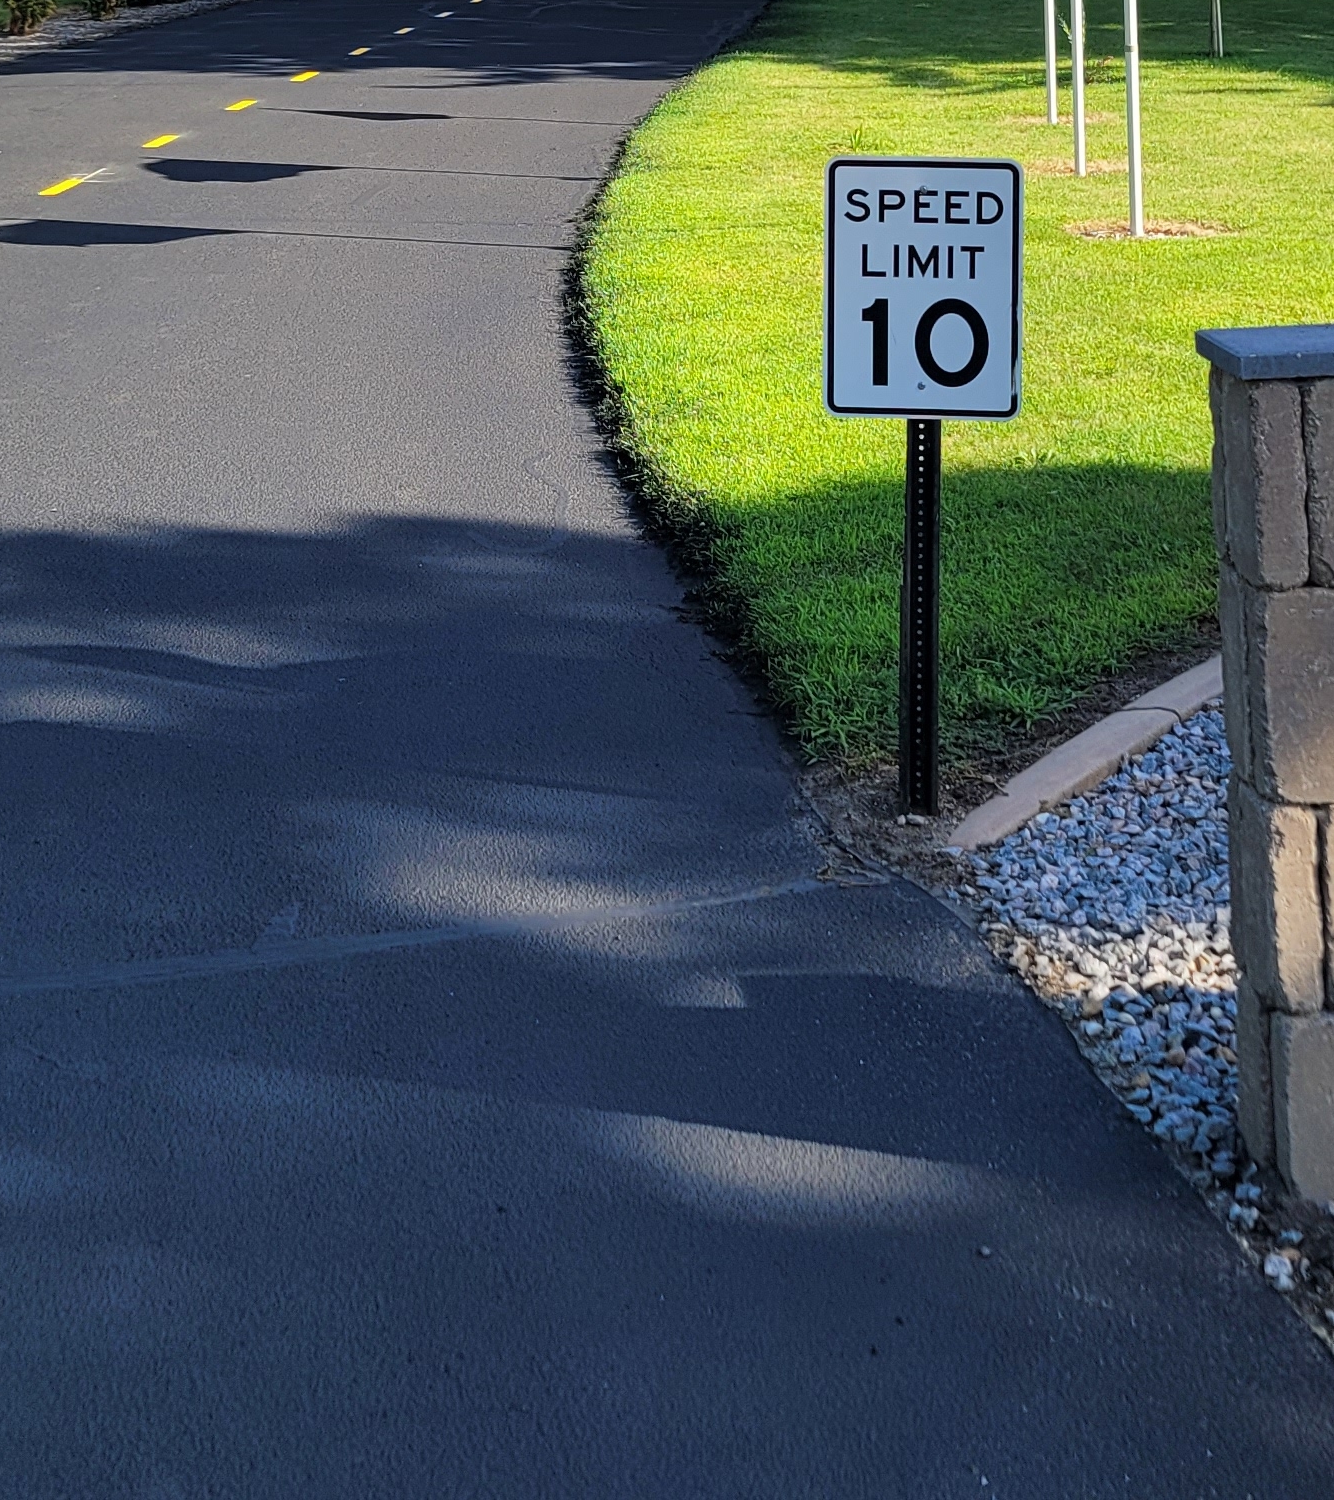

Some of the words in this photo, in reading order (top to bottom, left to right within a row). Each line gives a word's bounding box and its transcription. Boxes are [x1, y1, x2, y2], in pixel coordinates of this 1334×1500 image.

[844, 188, 1004, 225] SPEED
[861, 243, 985, 280] LIMIT
[861, 298, 989, 388] 10
